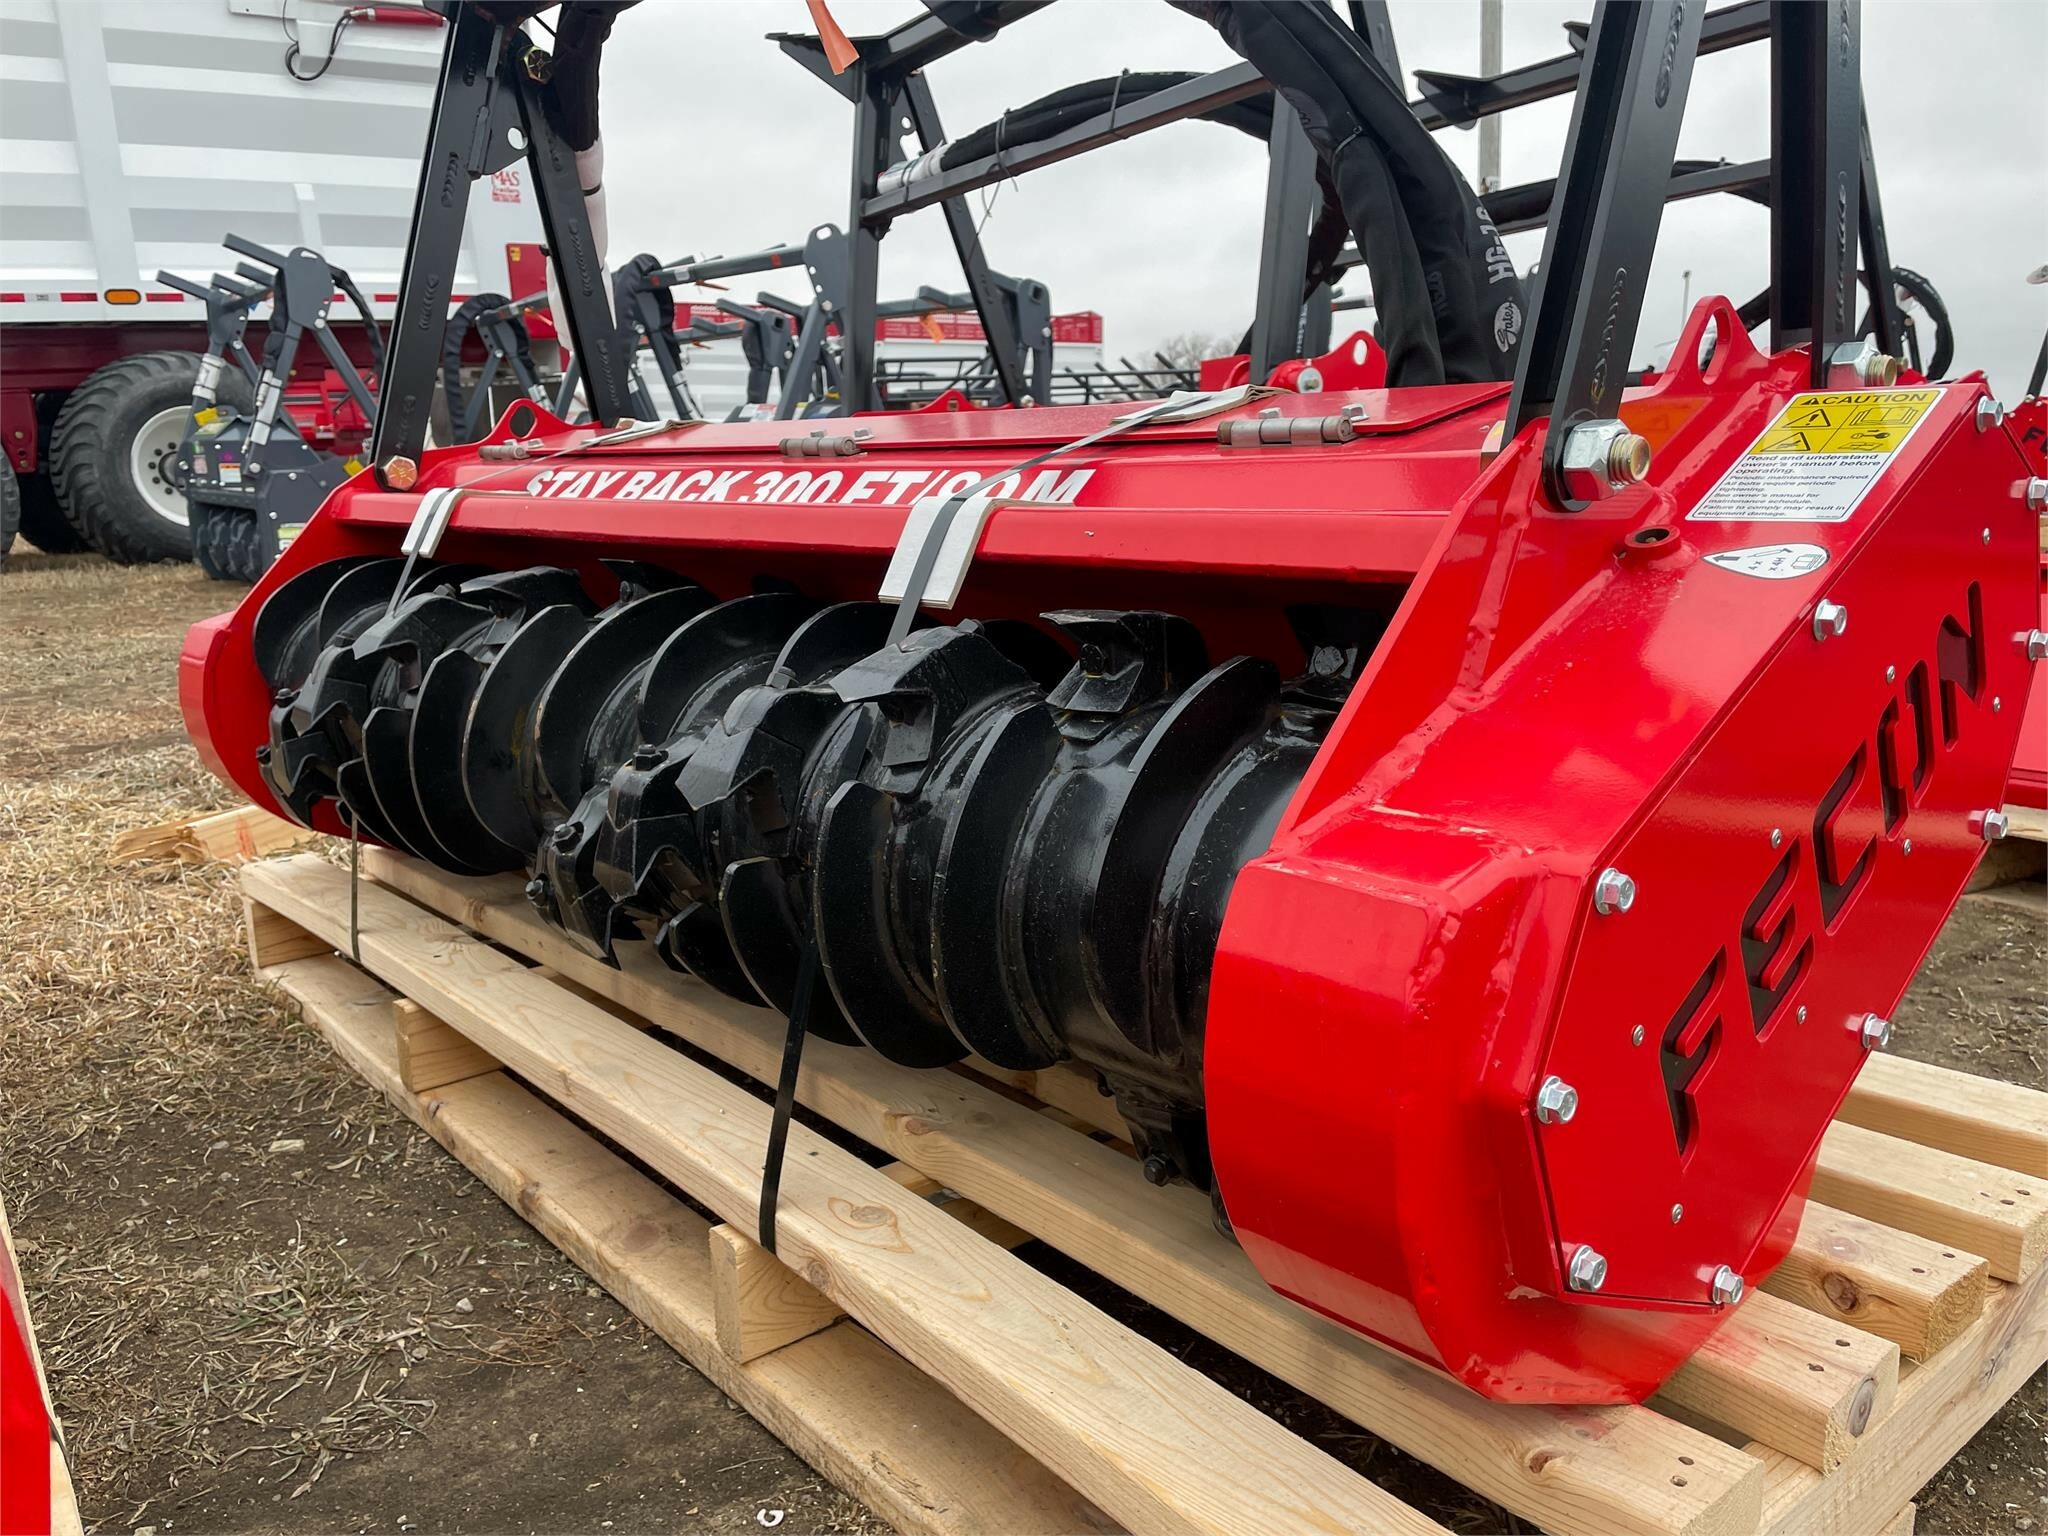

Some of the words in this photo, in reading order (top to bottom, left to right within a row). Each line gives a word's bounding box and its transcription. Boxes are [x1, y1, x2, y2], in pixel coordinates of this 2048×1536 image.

[1495, 302, 1519, 350] Gates
[1822, 393, 1928, 405] CAUTION
[526, 470, 628, 499] STAY
[613, 470, 752, 502] BACK
[737, 470, 843, 504] 300
[1659, 579, 1988, 1174] FECON
